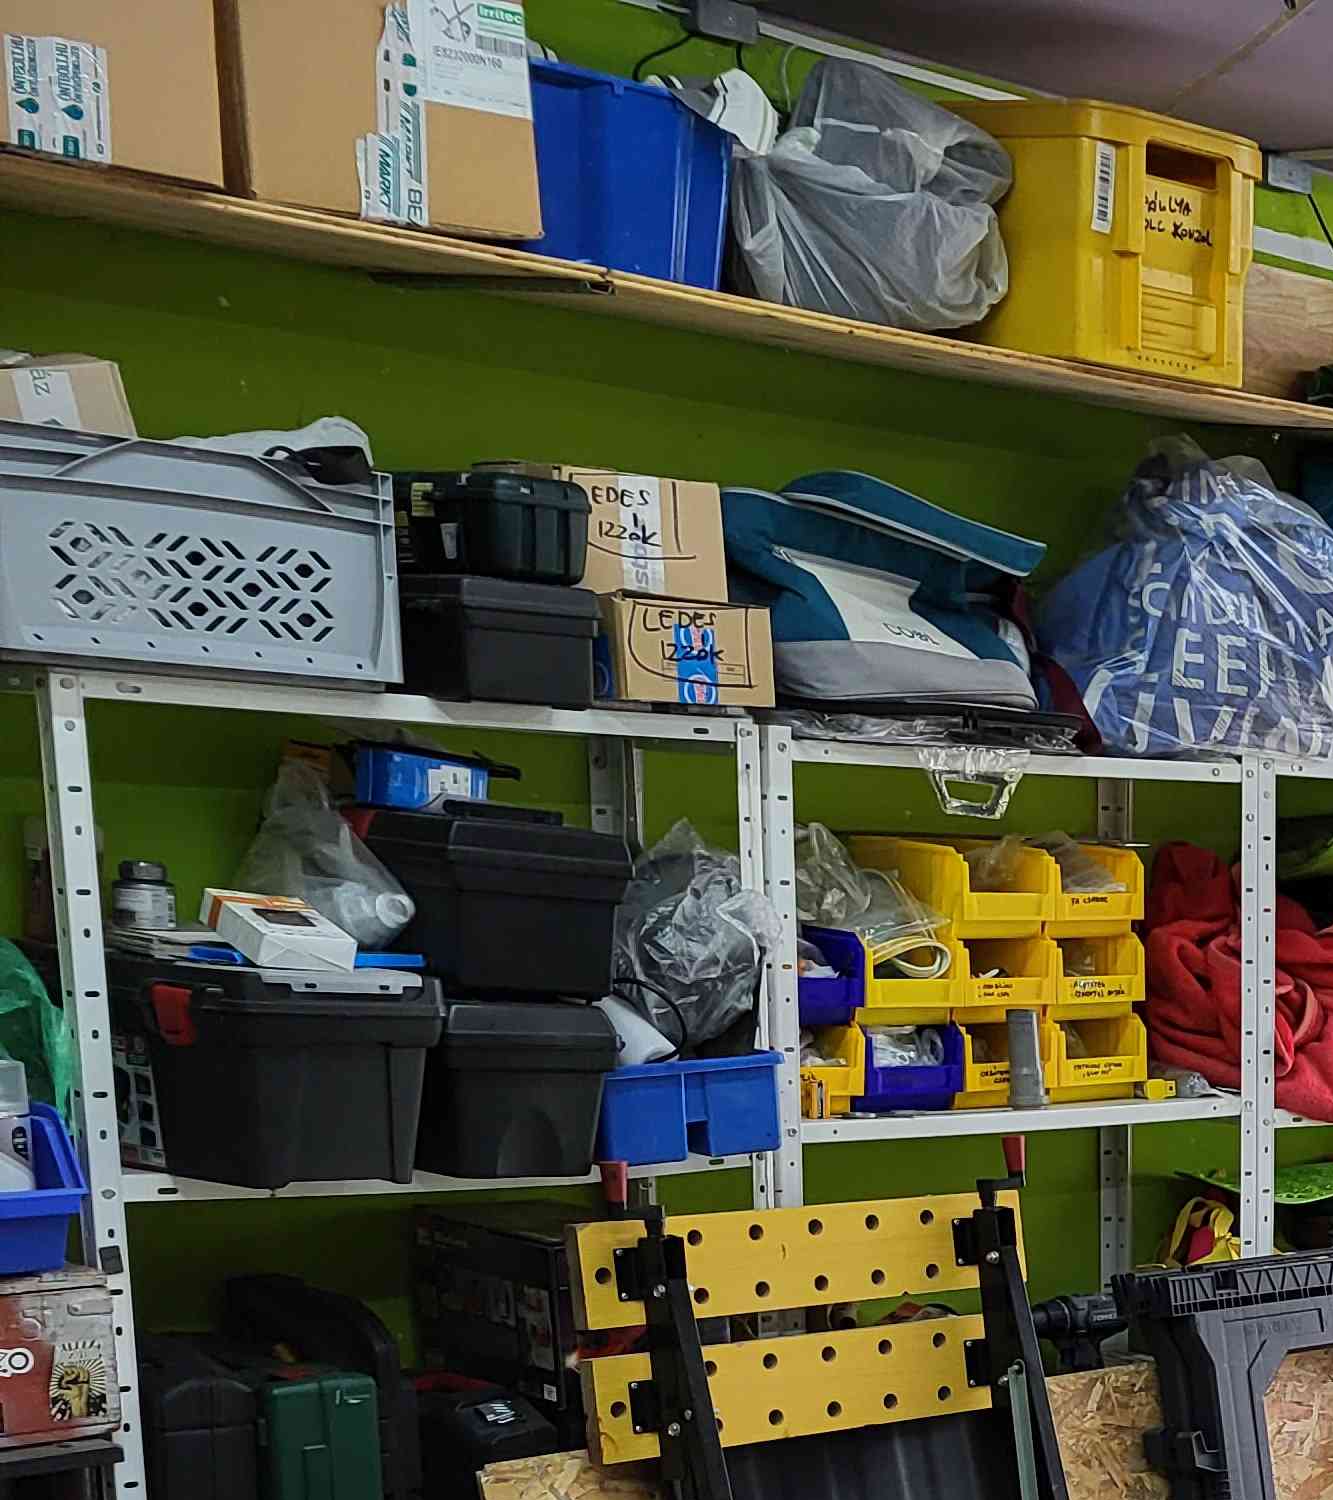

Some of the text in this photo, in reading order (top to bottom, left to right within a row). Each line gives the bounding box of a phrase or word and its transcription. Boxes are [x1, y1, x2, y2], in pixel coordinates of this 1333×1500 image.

[378, 147, 392, 213] MARKT
[591, 485, 650, 508] EDES
[642, 608, 717, 632] LEDES
